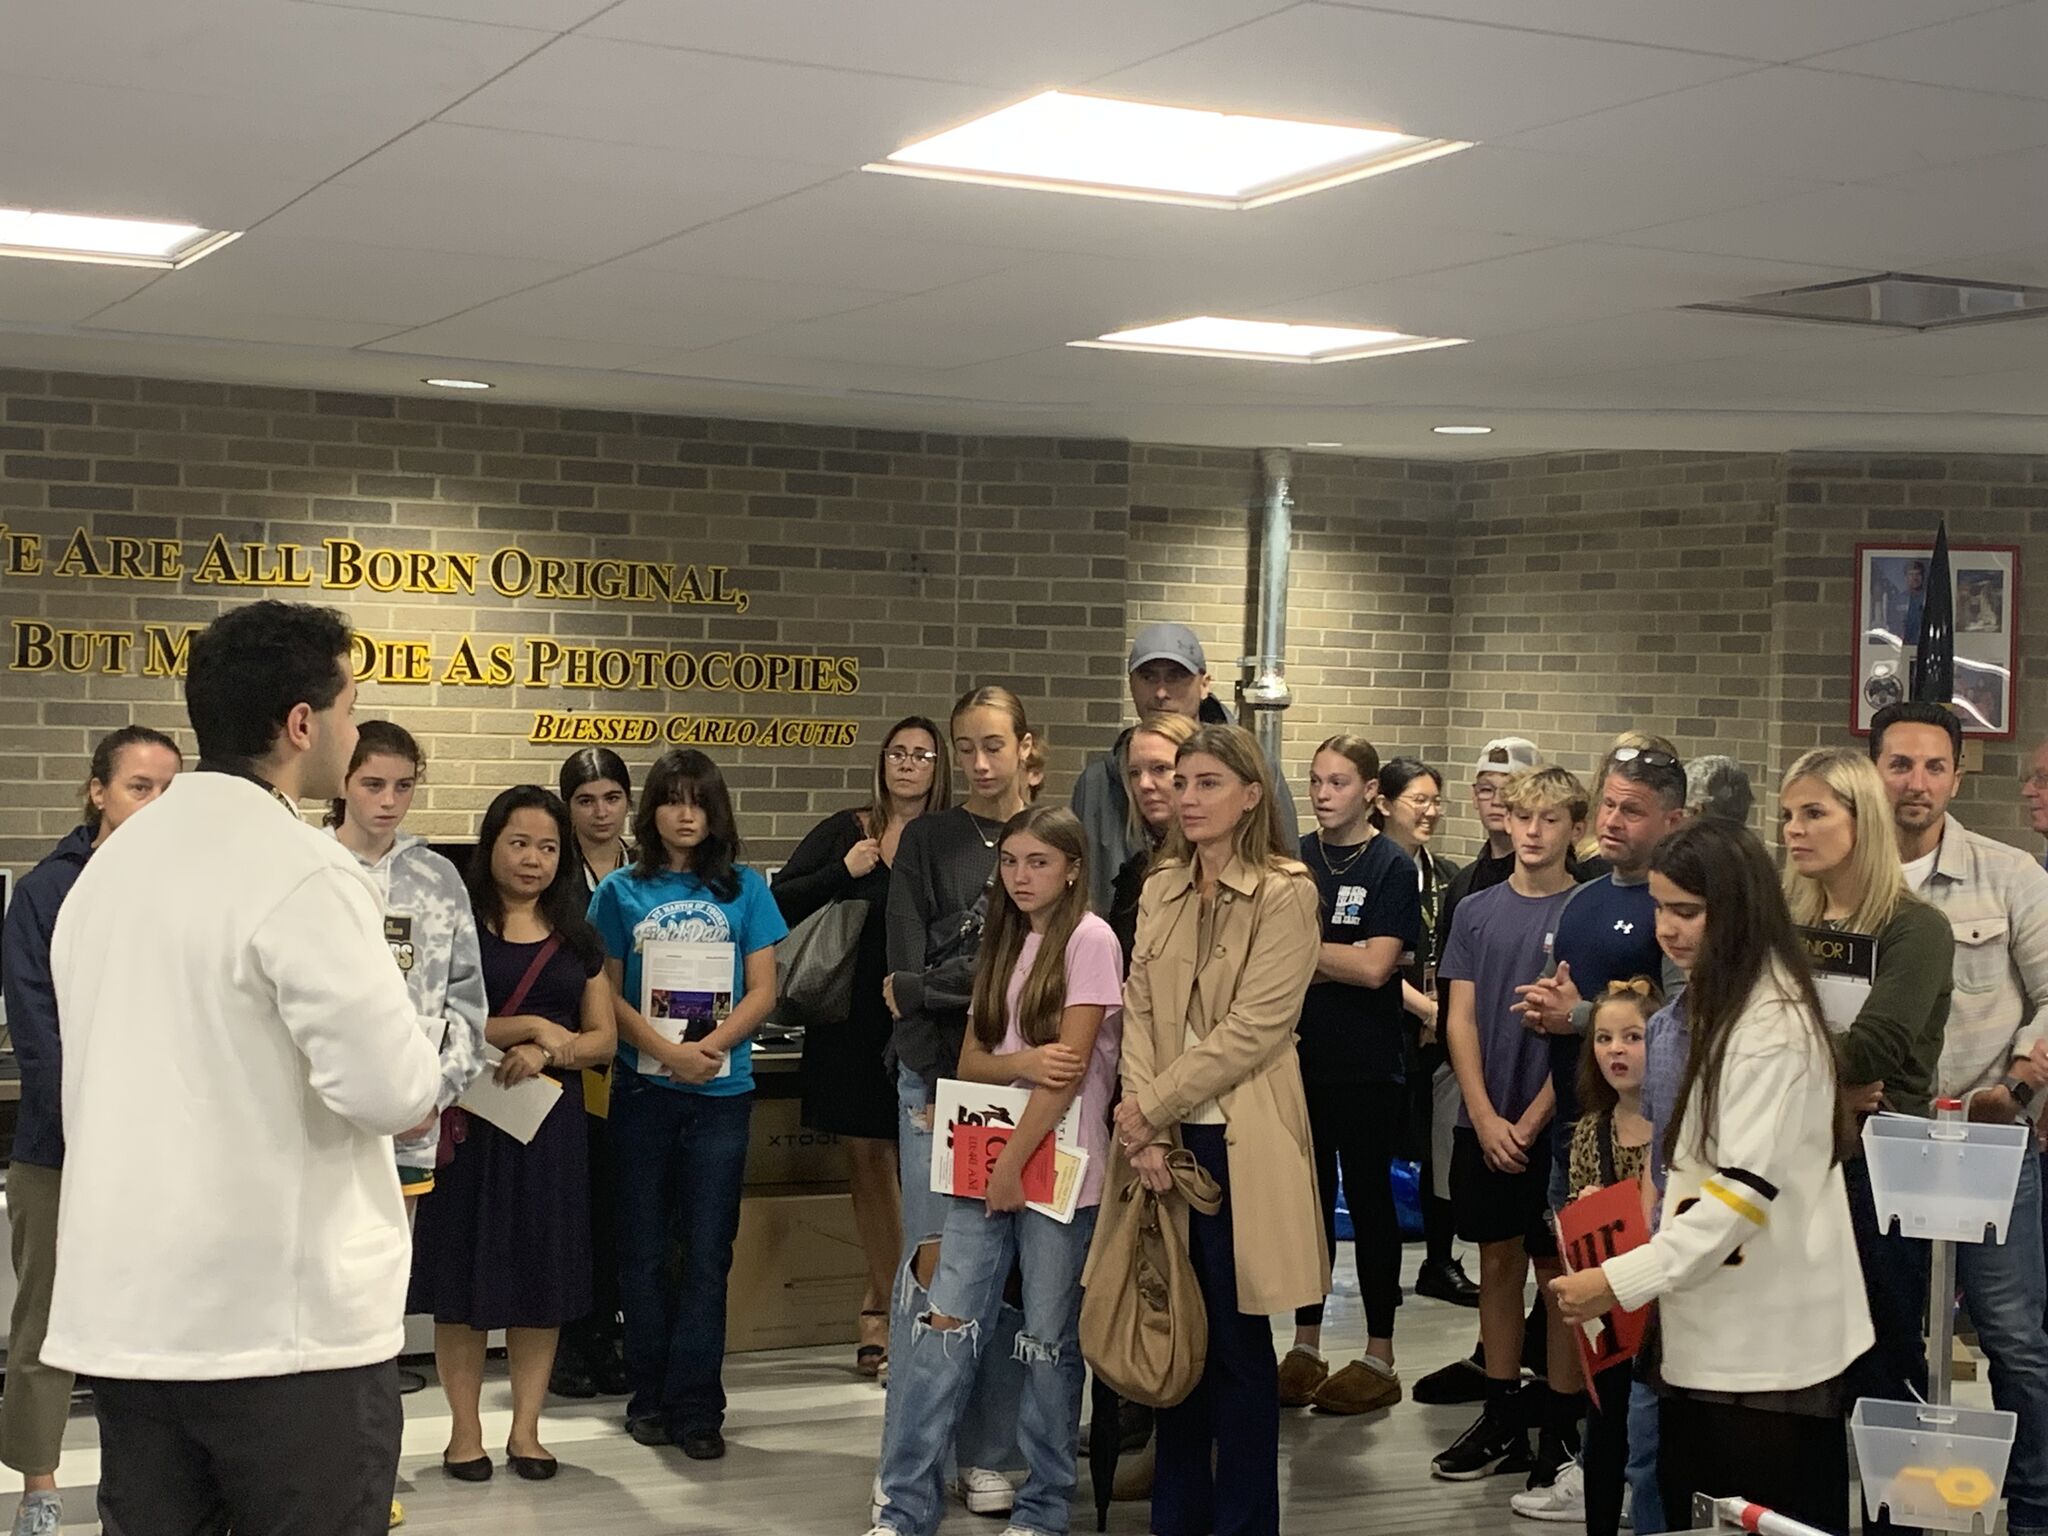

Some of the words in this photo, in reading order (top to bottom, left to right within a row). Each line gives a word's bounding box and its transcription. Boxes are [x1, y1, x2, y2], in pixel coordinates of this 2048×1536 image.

[0, 523, 43, 576] E
[57, 526, 184, 580] ARE
[193, 533, 312, 587] ALL
[322, 537, 479, 595] BORN
[489, 547, 750, 612] ORIGINAL,
[10, 620, 134, 674] BUT
[441, 634, 514, 688] AS
[524, 639, 860, 695] PHOTOCOPIES
[528, 710, 658, 744] BLESSED
[664, 715, 755, 746] CARLO
[758, 719, 859, 747] ACUTIS
[663, 902, 694, 914] MARTIN
[694, 902, 705, 911] OF
[767, 1133, 841, 1147] XTOOL
